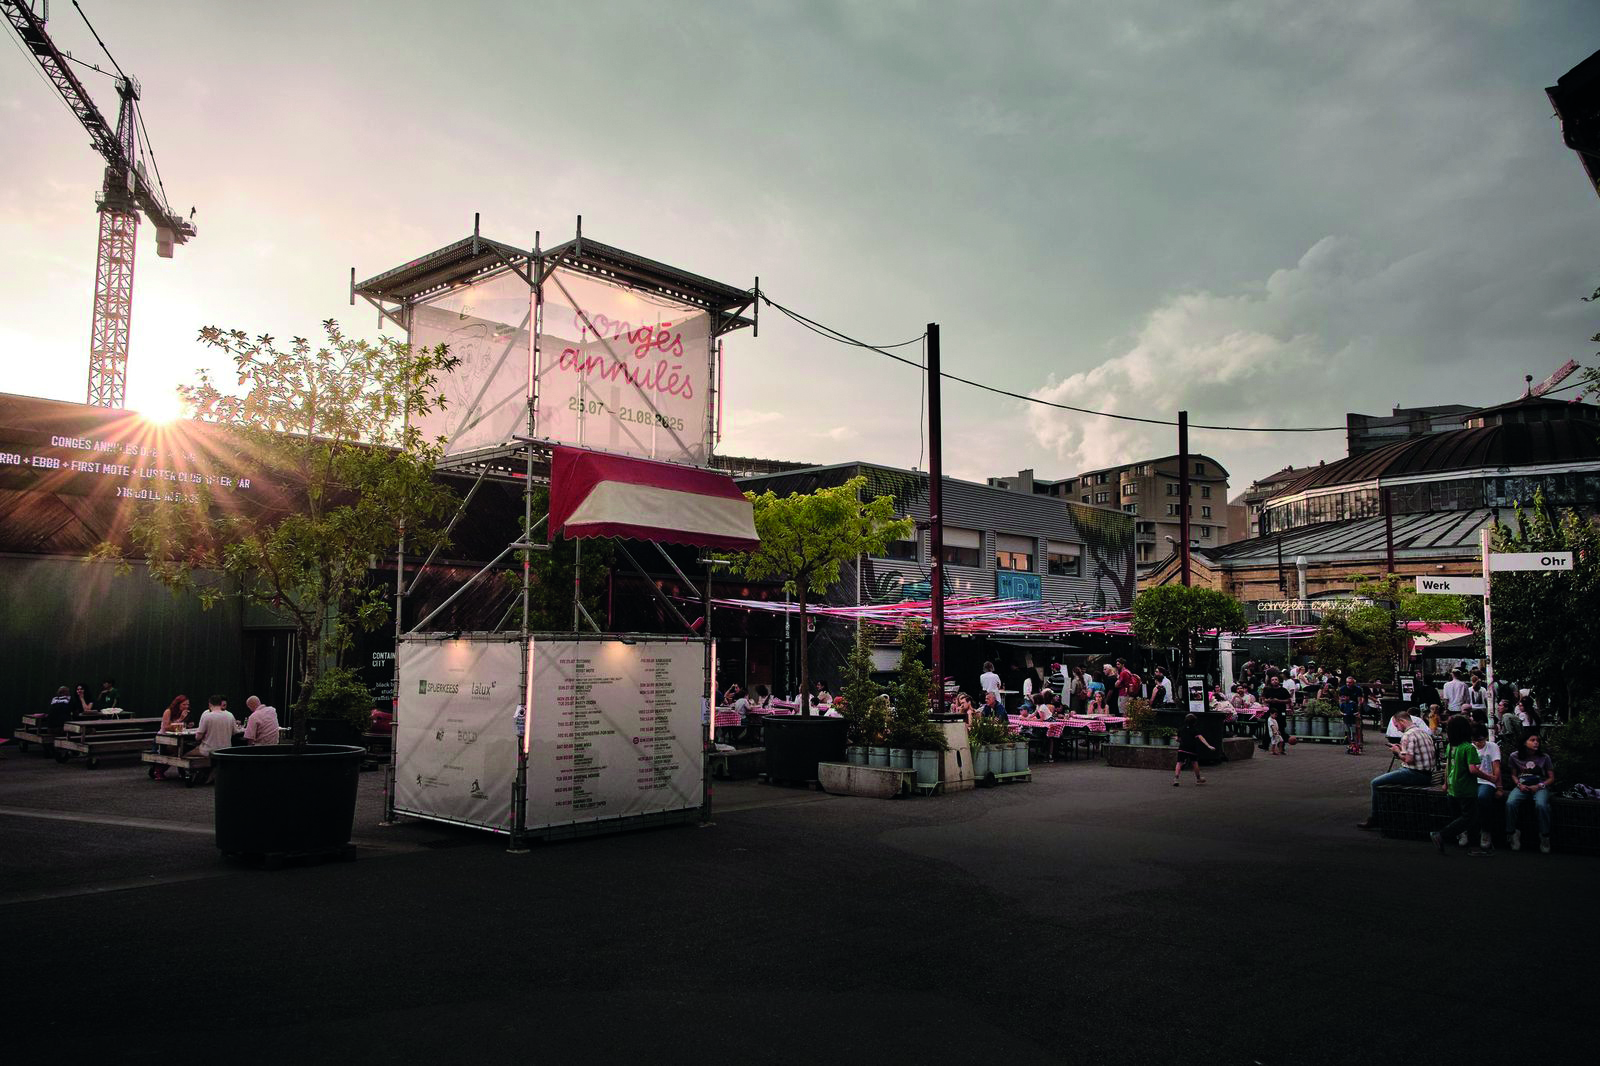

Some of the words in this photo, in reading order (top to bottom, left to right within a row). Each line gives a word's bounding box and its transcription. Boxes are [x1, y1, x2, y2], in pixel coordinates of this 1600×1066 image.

[569, 396, 604, 416] 25.07
[71, 459, 101, 473] FIRST
[102, 463, 130, 477] MOTE
[236, 476, 250, 489] AR
[1541, 557, 1567, 567] Ohr
[1422, 580, 1450, 591] Werk
[372, 660, 386, 668] CITY
